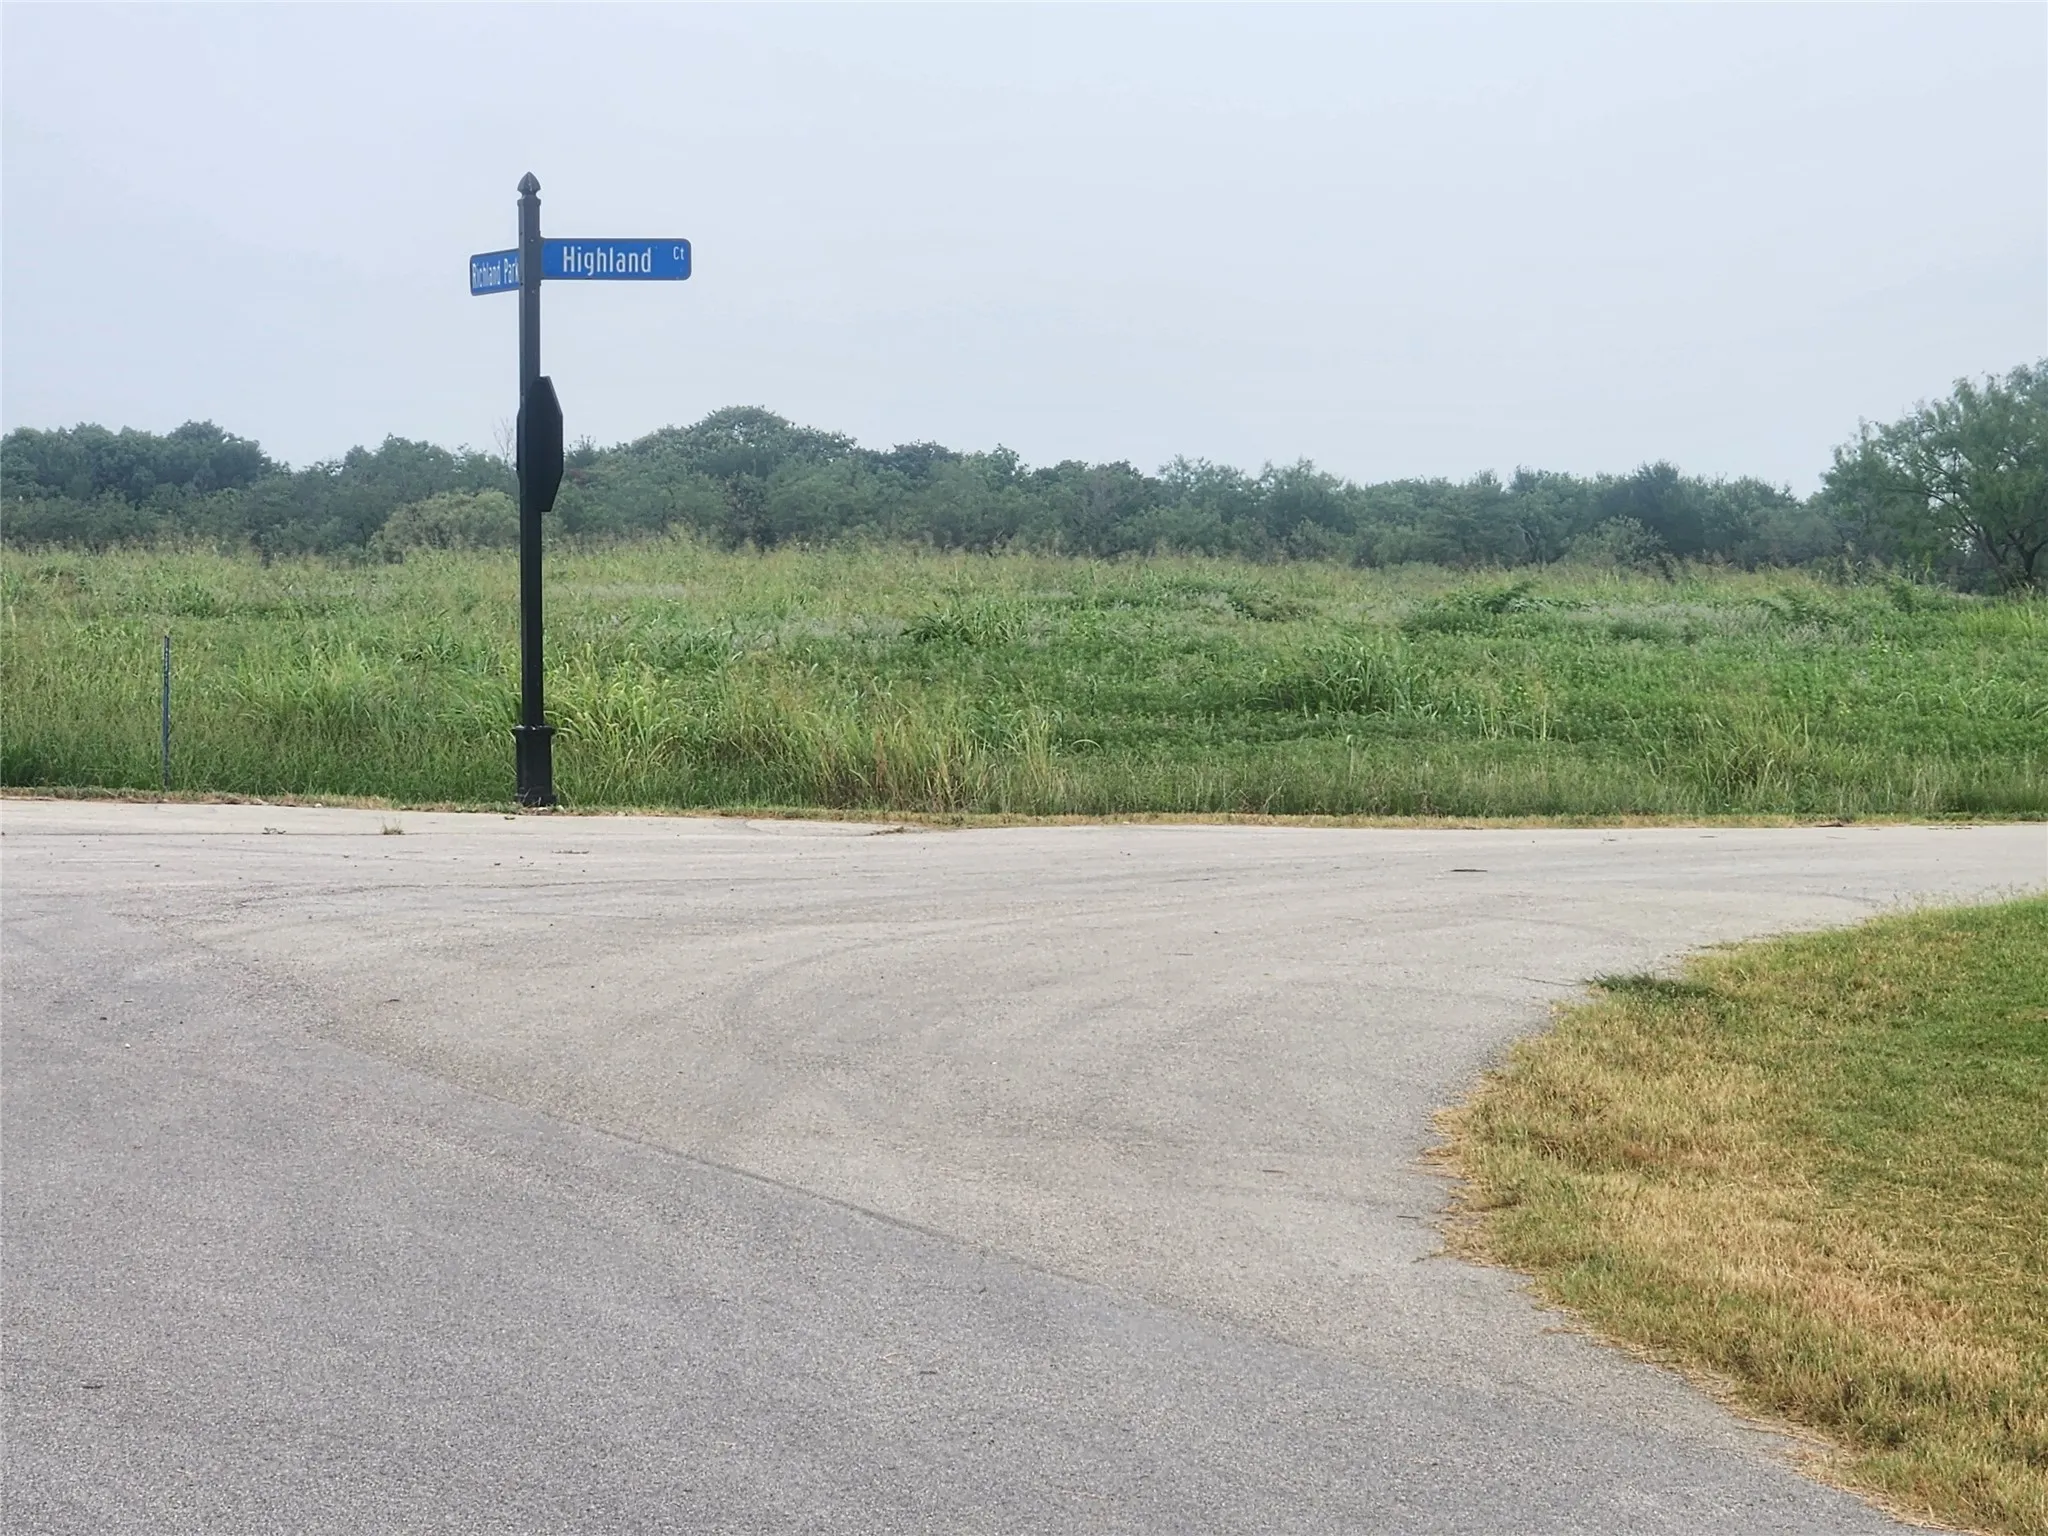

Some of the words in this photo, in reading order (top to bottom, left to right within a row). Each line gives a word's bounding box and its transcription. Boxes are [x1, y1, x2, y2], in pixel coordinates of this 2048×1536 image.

[472, 260, 500, 288] Richland
[504, 257, 519, 284] Park
[563, 246, 651, 276] Highland
[673, 246, 685, 260] Ct
